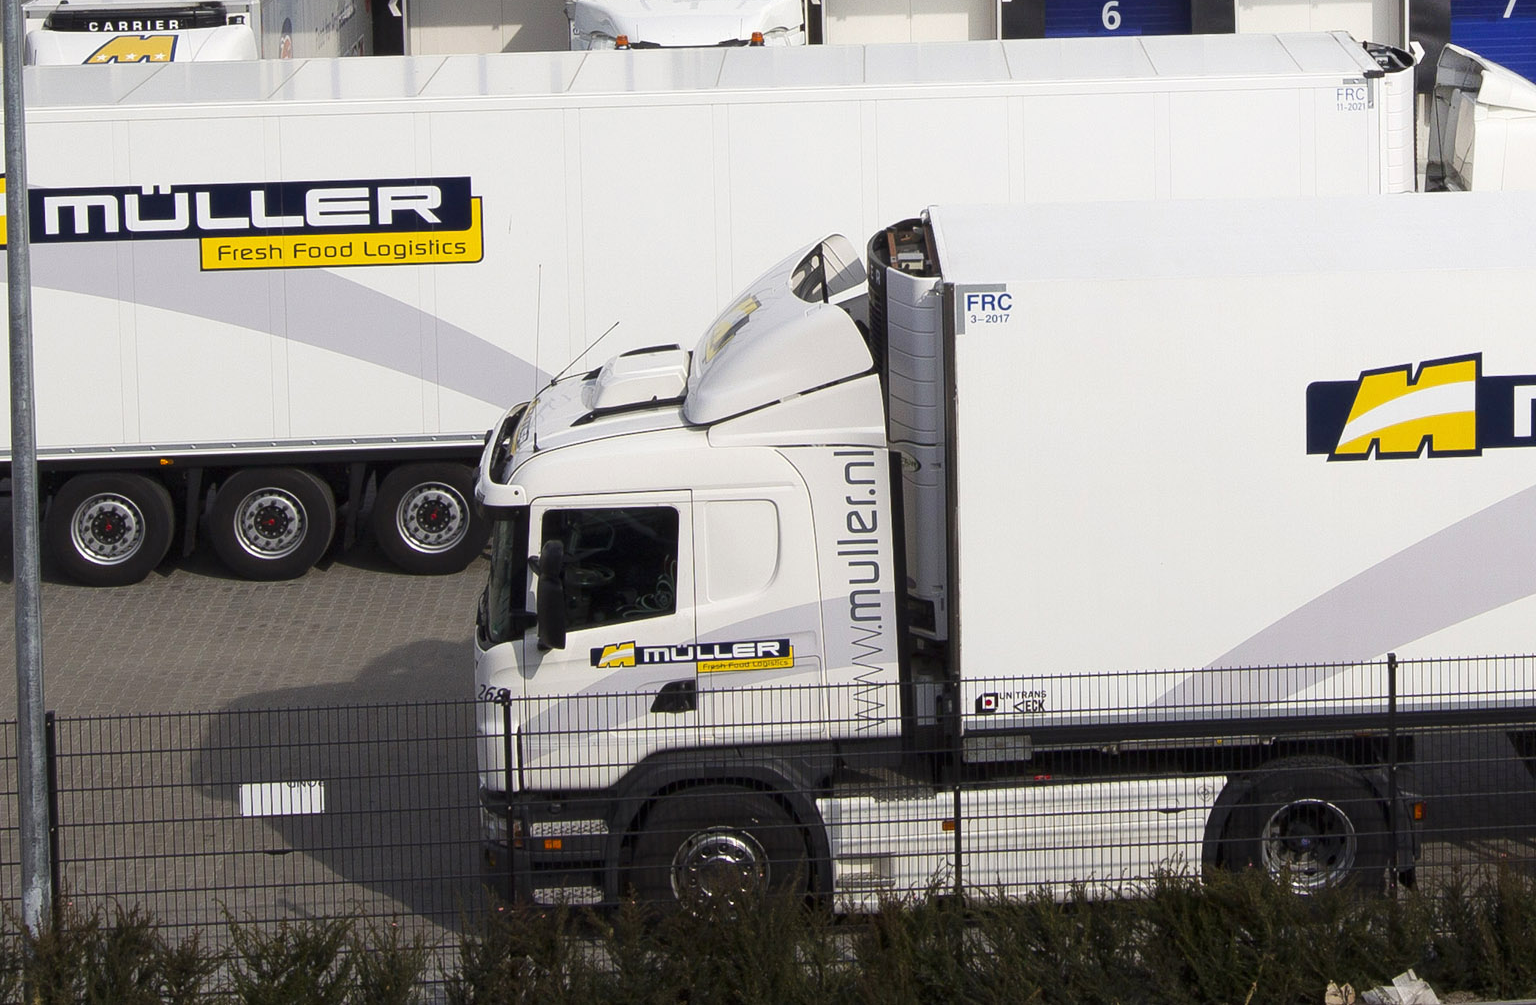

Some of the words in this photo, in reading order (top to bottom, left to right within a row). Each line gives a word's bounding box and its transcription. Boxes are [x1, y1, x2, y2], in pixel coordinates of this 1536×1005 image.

[1102, 0, 1121, 30] 6
[88, 19, 181, 33] CARRIER
[1336, 87, 1365, 101] FRC
[1336, 102, 1366, 111] 11-2021
[44, 184, 443, 235] MÜLLER
[217, 244, 282, 261] Fresh
[293, 242, 353, 259] Food
[364, 238, 467, 260] Logistics
[967, 293, 1013, 311] FRC
[834, 451, 885, 732] www.muller.nl
[644, 641, 780, 662] MÜLLER
[702, 662, 726, 670] Fresh
[729, 661, 750, 669] Food
[753, 659, 789, 668] Logistics
